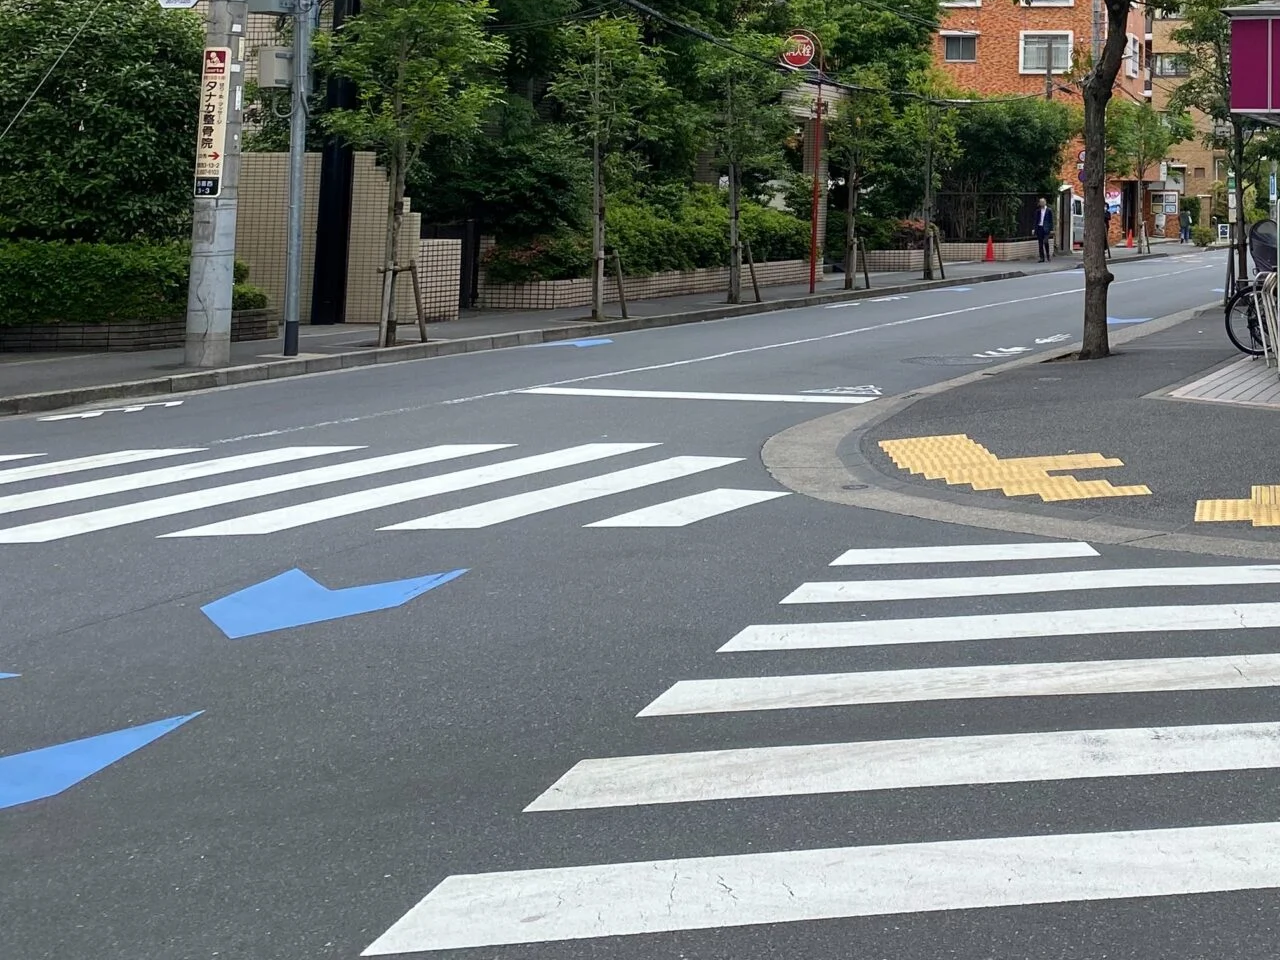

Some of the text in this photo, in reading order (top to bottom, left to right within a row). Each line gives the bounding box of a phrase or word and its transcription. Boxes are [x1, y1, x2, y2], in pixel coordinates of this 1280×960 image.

[201, 81, 218, 149] タナカ整骨院
